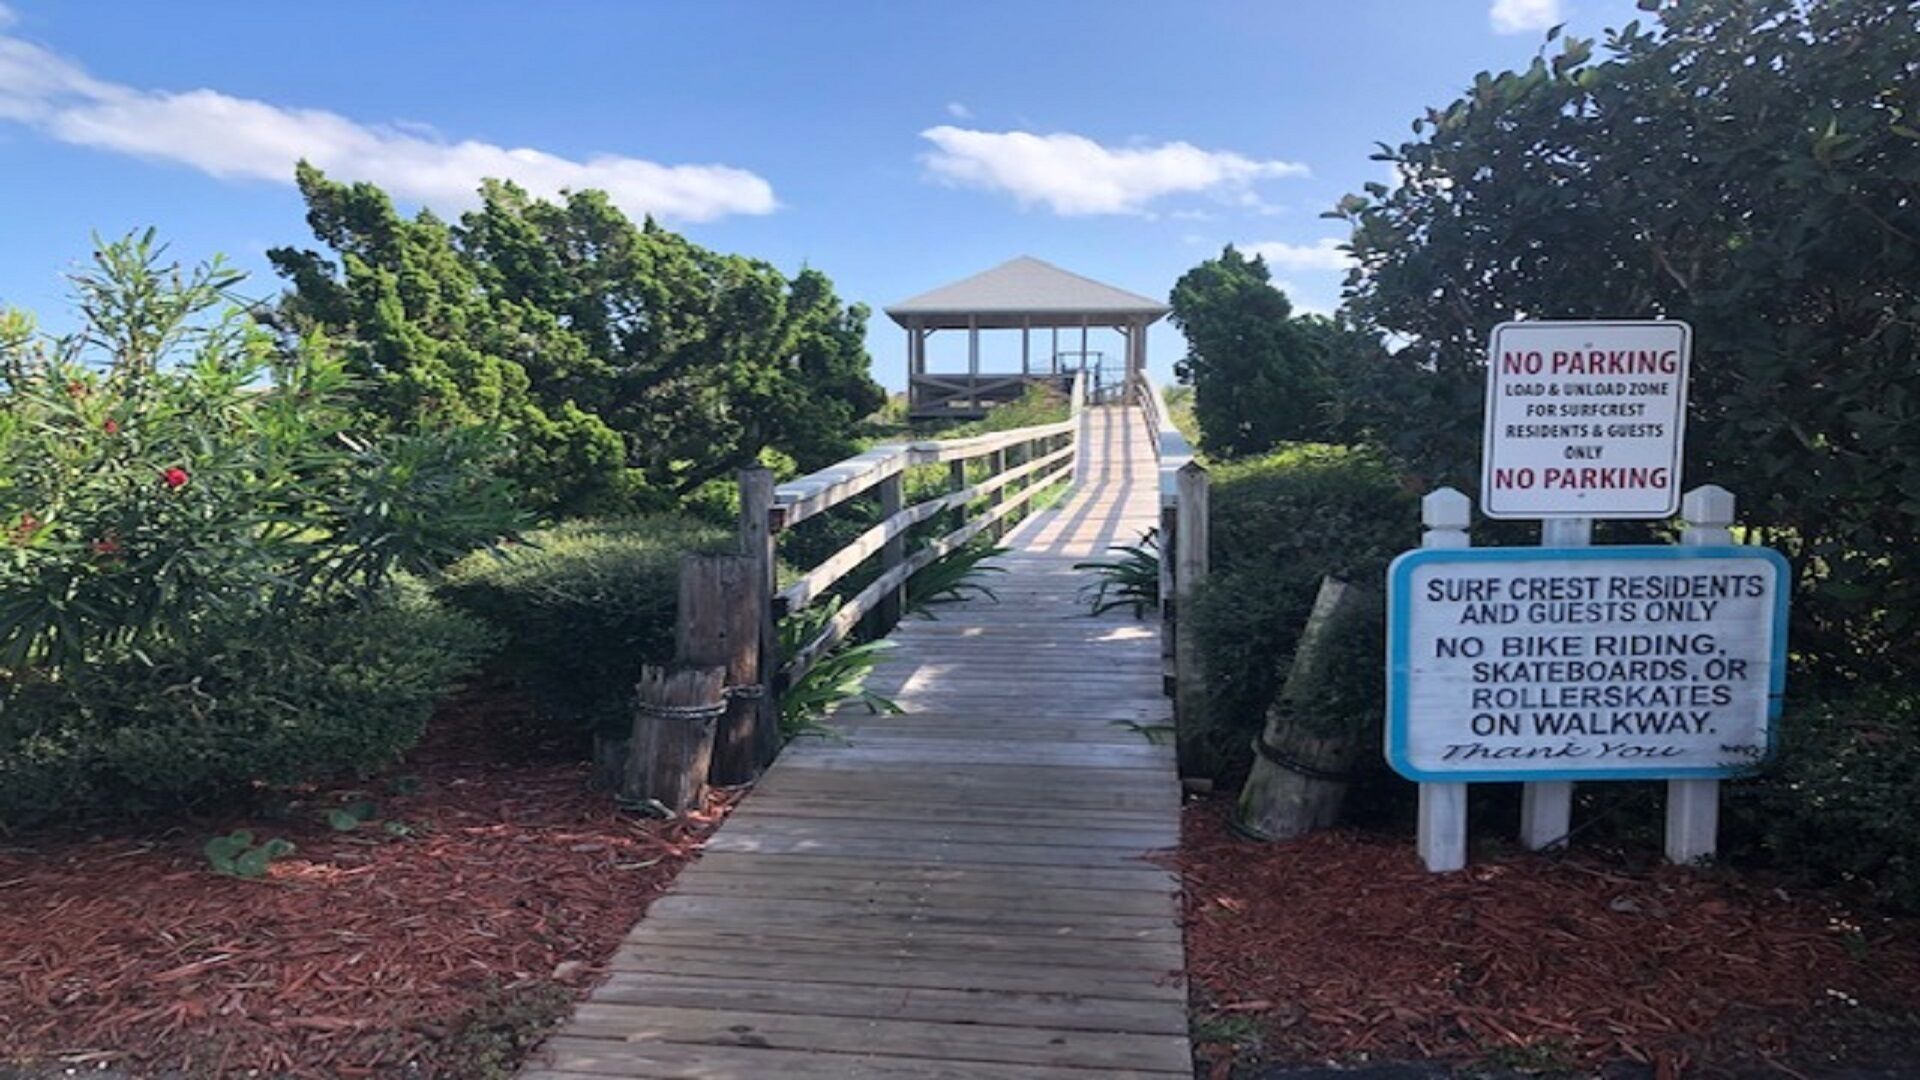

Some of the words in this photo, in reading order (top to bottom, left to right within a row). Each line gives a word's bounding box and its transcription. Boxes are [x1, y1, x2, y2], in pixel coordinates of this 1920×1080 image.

[1503, 352, 1543, 374] NO
[1552, 350, 1677, 374] PARKING
[1505, 383, 1545, 396] LOAD
[1549, 383, 1559, 396] &
[1564, 383, 1626, 396] UNLOAD
[1629, 383, 1669, 396] ZONE
[1526, 404, 1559, 417] FOR
[1560, 404, 1644, 417] SURFCREST
[1506, 424, 1588, 438] RESIDENTS
[1592, 424, 1602, 437] &
[1607, 424, 1664, 437] GUESTS
[1564, 446, 1603, 459] ONLY
[1496, 469, 1534, 489] NO
[1544, 467, 1667, 489] PARKING
[1427, 578, 1500, 601] SURF
[1508, 577, 1599, 601] CREST
[1609, 575, 1764, 599] RESIDENTS
[1460, 604, 1518, 624] AND
[1527, 602, 1636, 623] GUESTS
[1645, 601, 1718, 622] ONLY
[1435, 637, 1484, 658] NO
[1502, 636, 1584, 657] BIKE
[1704, 659, 1748, 680] OR
[1471, 686, 1731, 709] ROLLERSKATES
[1471, 714, 1520, 736] ON
[1533, 711, 1716, 736] WALKWAY.
[1442, 743, 1590, 760] Thank
[1592, 742, 1685, 758] You
